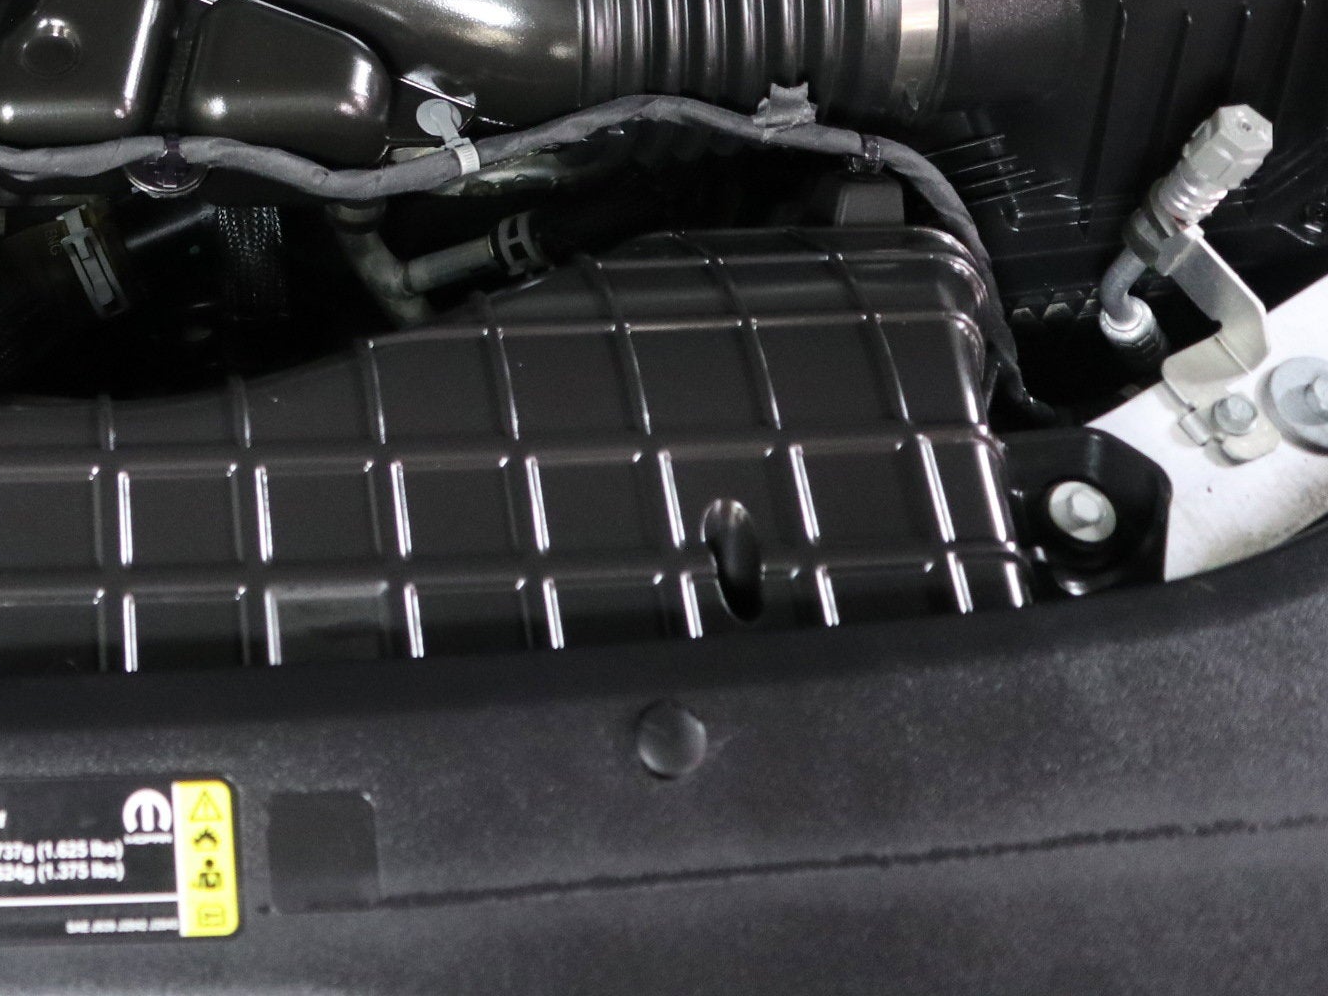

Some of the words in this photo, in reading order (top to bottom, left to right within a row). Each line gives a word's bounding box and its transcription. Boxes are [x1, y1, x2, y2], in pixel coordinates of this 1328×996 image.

[89, 838, 125, 862] lbs)
[37, 860, 90, 885] (1.375
[90, 859, 126, 883] lbs)
